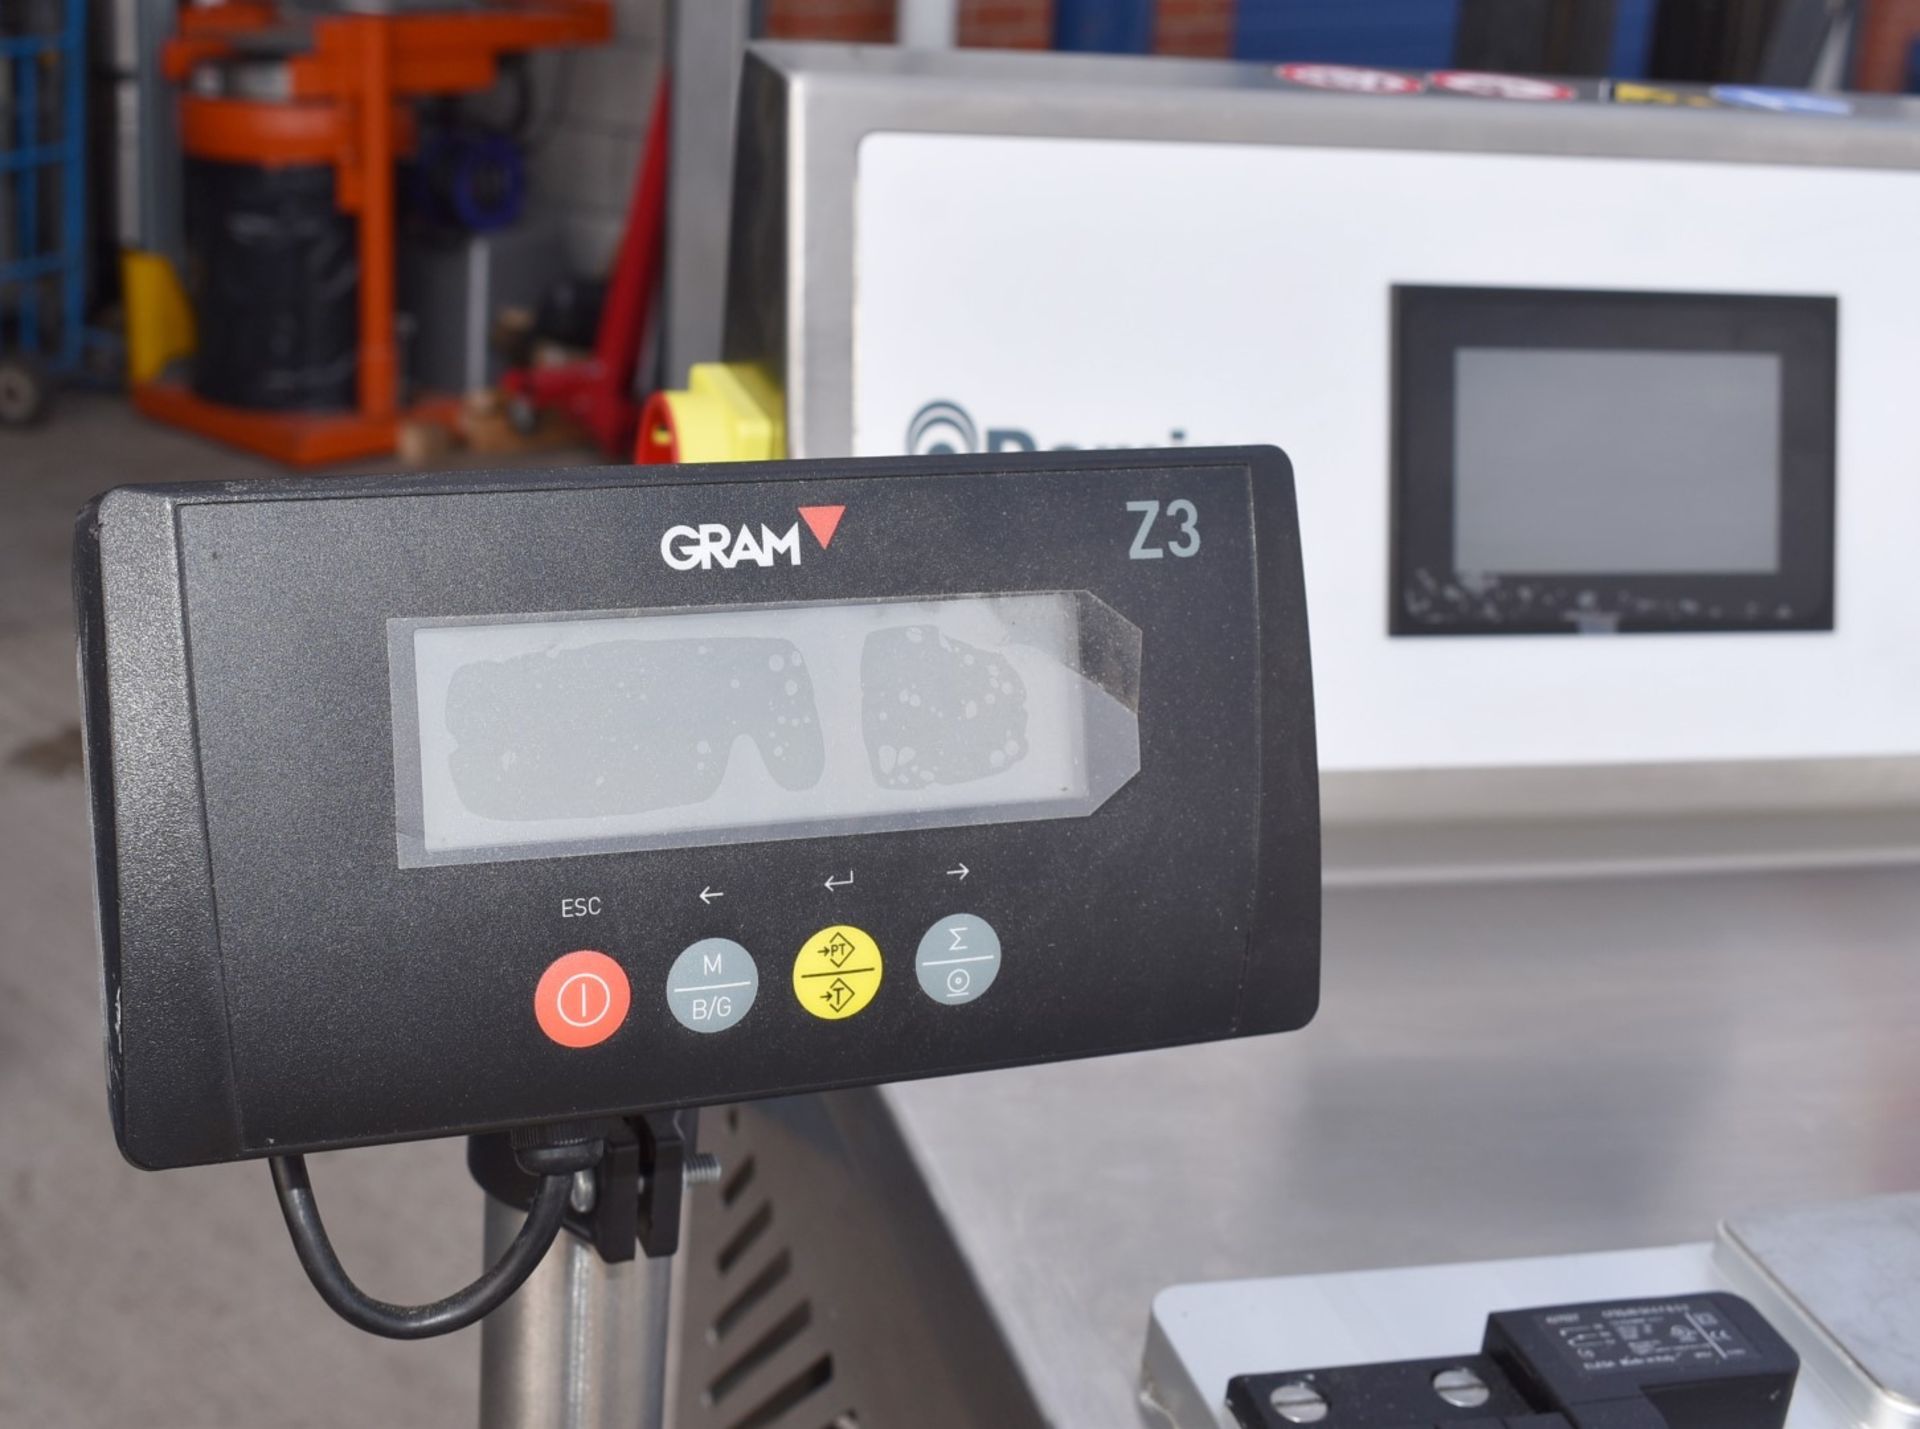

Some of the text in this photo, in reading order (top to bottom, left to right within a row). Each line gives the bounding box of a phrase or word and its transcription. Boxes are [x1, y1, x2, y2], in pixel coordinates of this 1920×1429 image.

[1125, 499, 1201, 560] Z3
[660, 521, 802, 571] GRAM
[561, 896, 601, 918] ESC
[830, 943, 846, 957] PT
[703, 952, 722, 976] M
[692, 995, 732, 1021] B/G
[832, 986, 845, 1006] T
